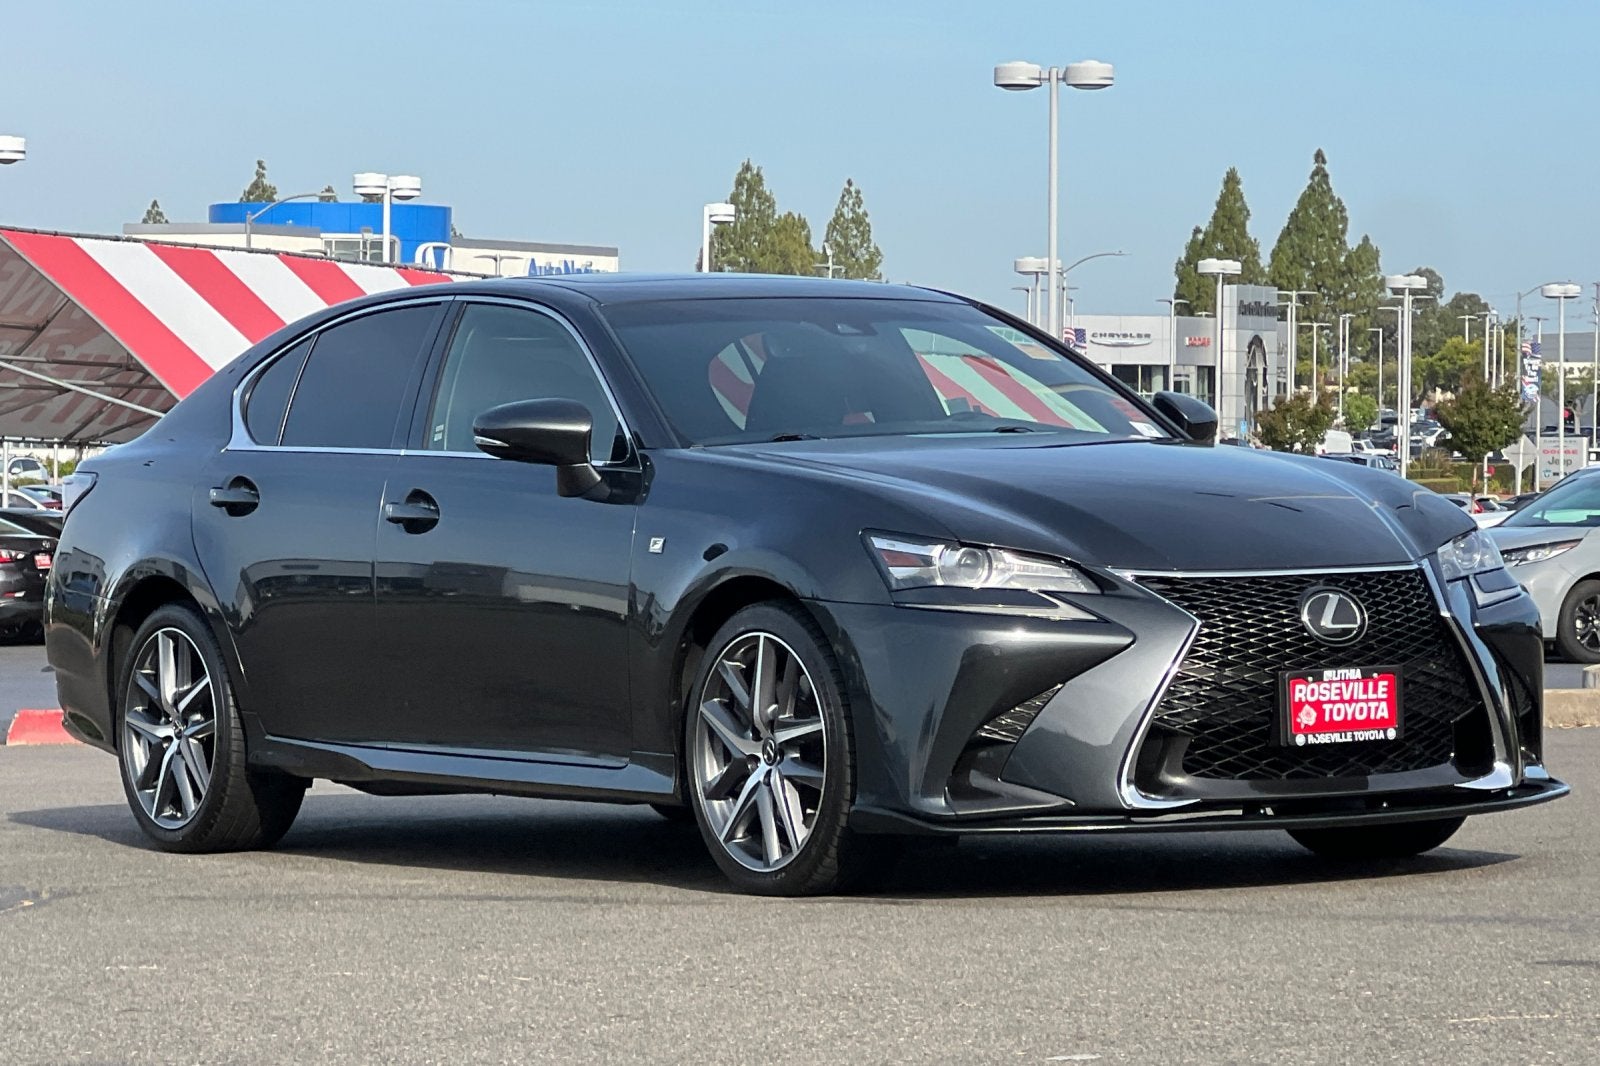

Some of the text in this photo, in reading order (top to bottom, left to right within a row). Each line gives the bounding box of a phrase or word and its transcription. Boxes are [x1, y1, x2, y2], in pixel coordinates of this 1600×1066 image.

[1547, 456, 1573, 467] Jep
[1294, 680, 1389, 702] ROSEVILLE
[1322, 701, 1389, 722] TOYOTA
[1307, 729, 1385, 744] ROSEVILLE TOYOTA
